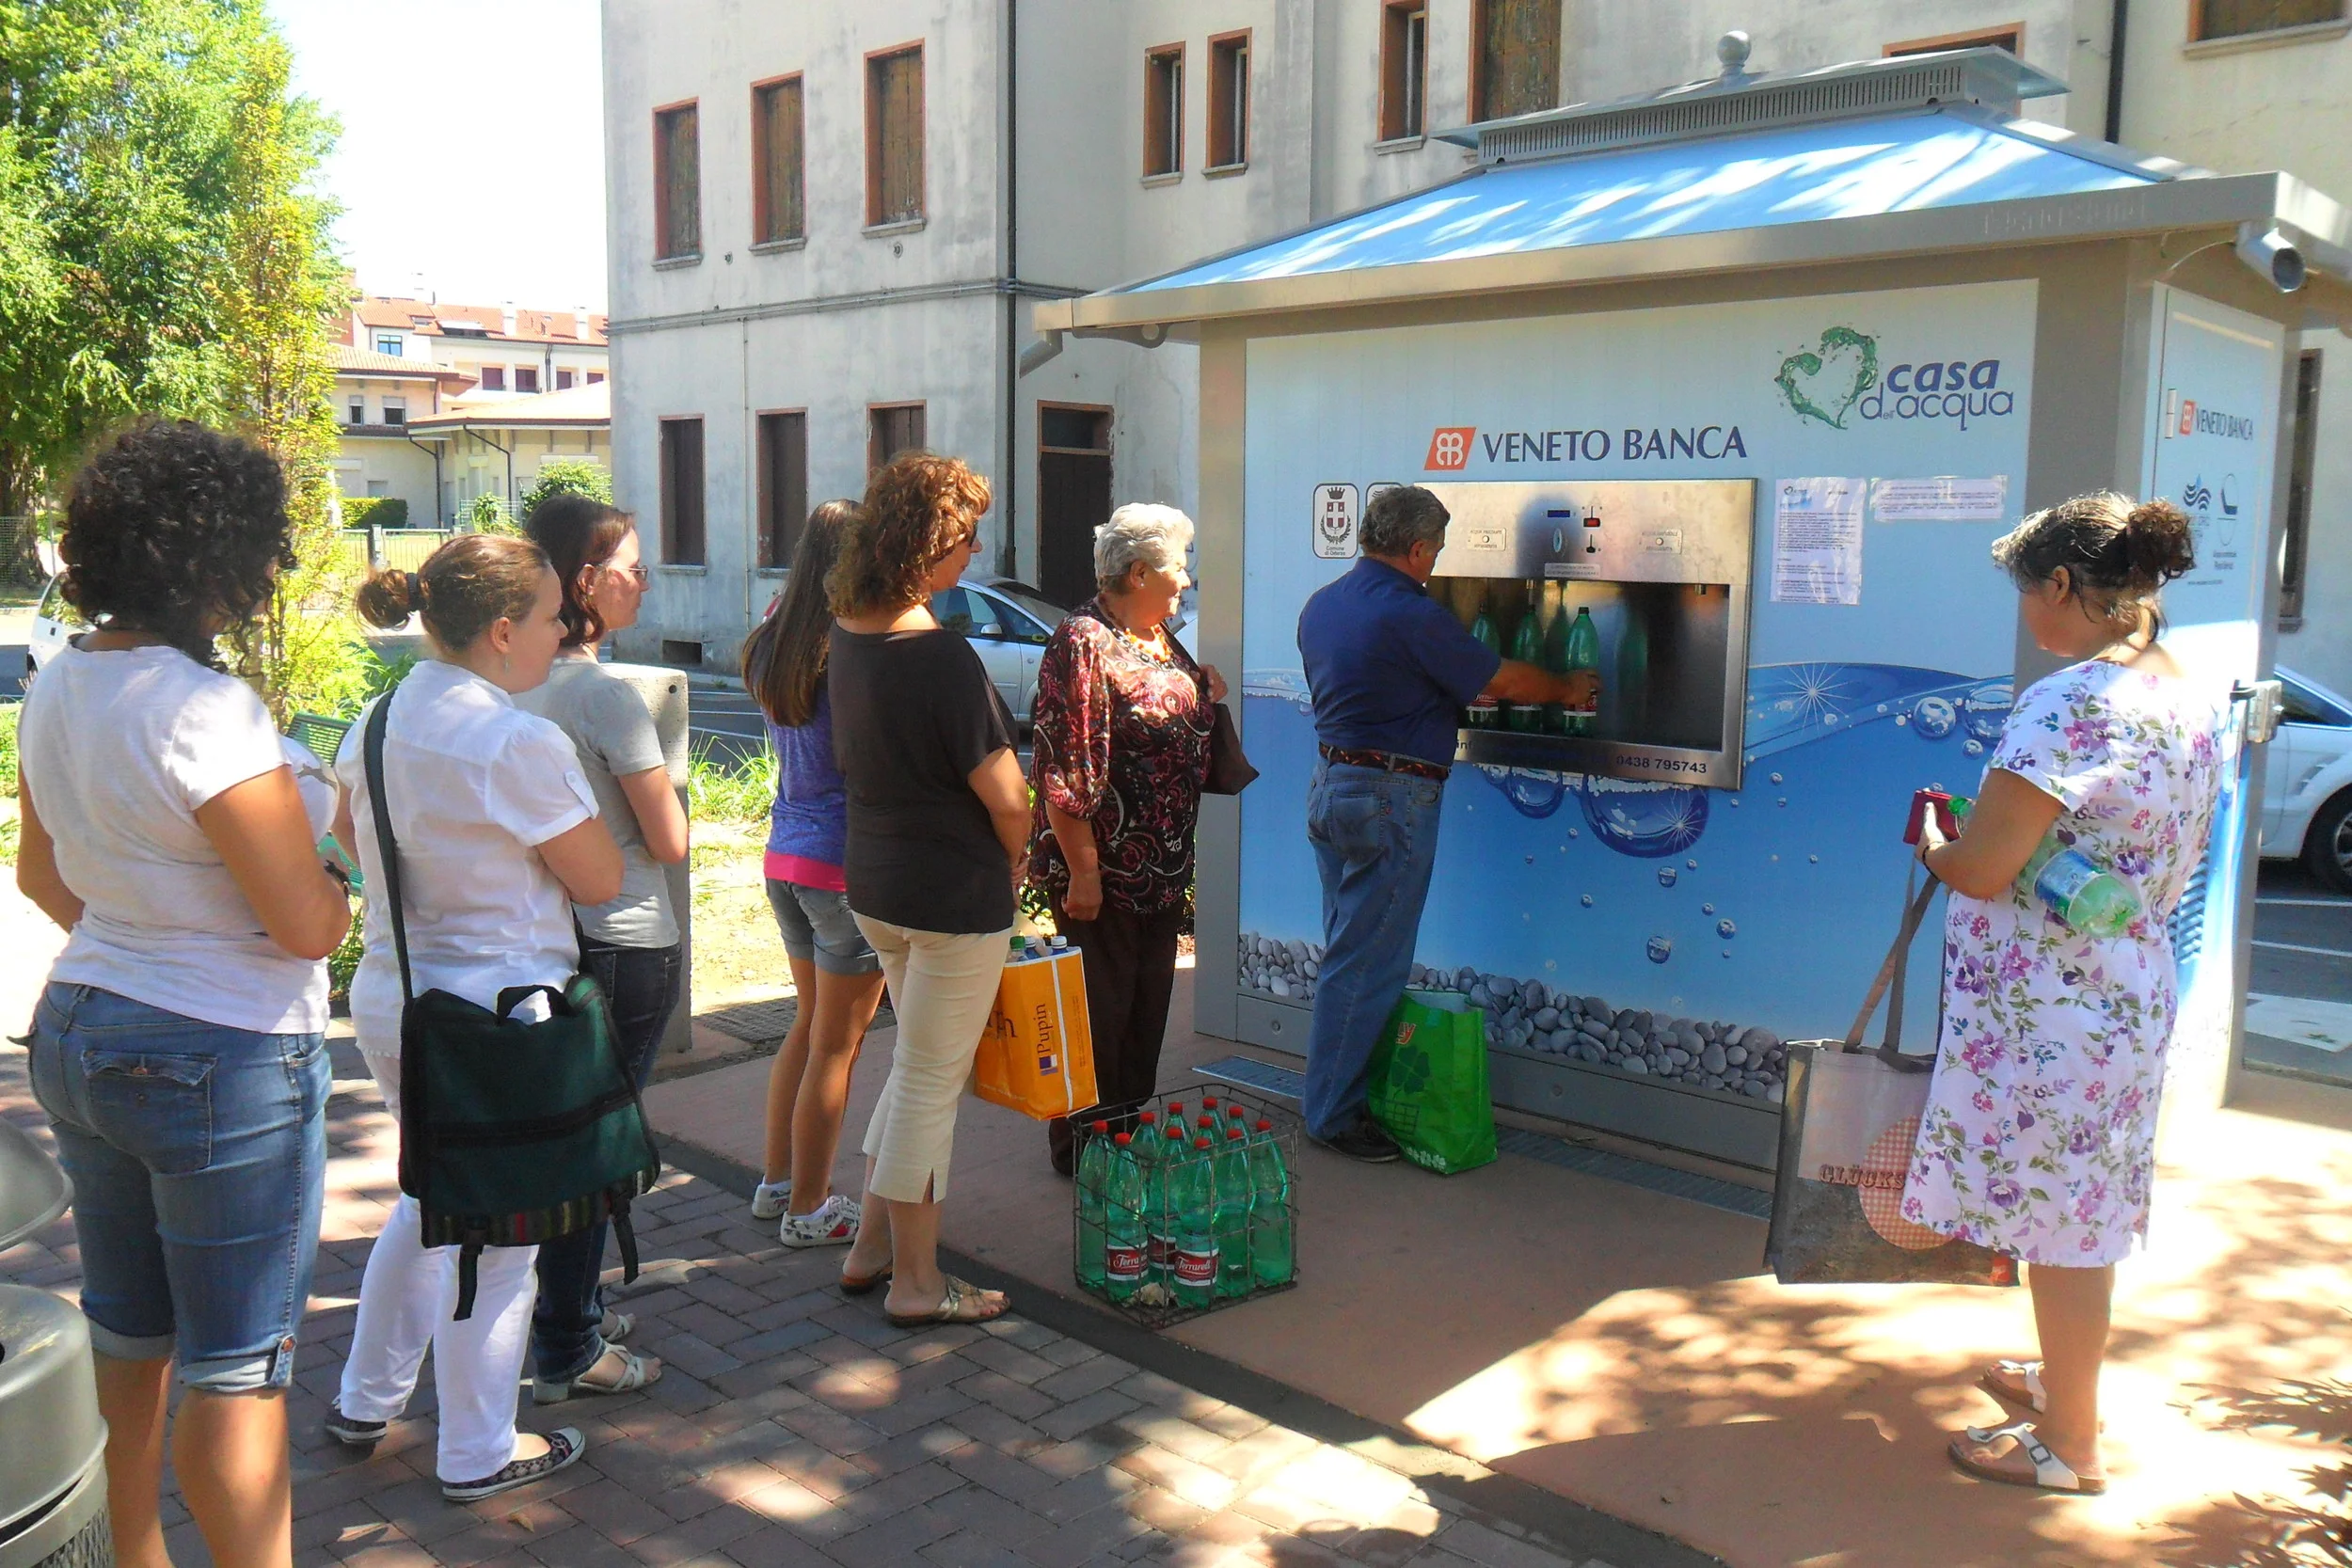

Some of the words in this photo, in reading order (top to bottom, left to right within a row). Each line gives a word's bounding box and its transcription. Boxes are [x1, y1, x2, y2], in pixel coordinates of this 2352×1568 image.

[1886, 359, 2000, 393] casa
[2196, 406, 2226, 436] VENETO
[2227, 415, 2253, 440] BANCA
[1483, 430, 1611, 463] VENETO
[1623, 426, 1747, 460] BANCA
[1616, 755, 1650, 768] 0438
[1655, 759, 1708, 774] 795743
[1034, 1004, 1054, 1053] Pupin
